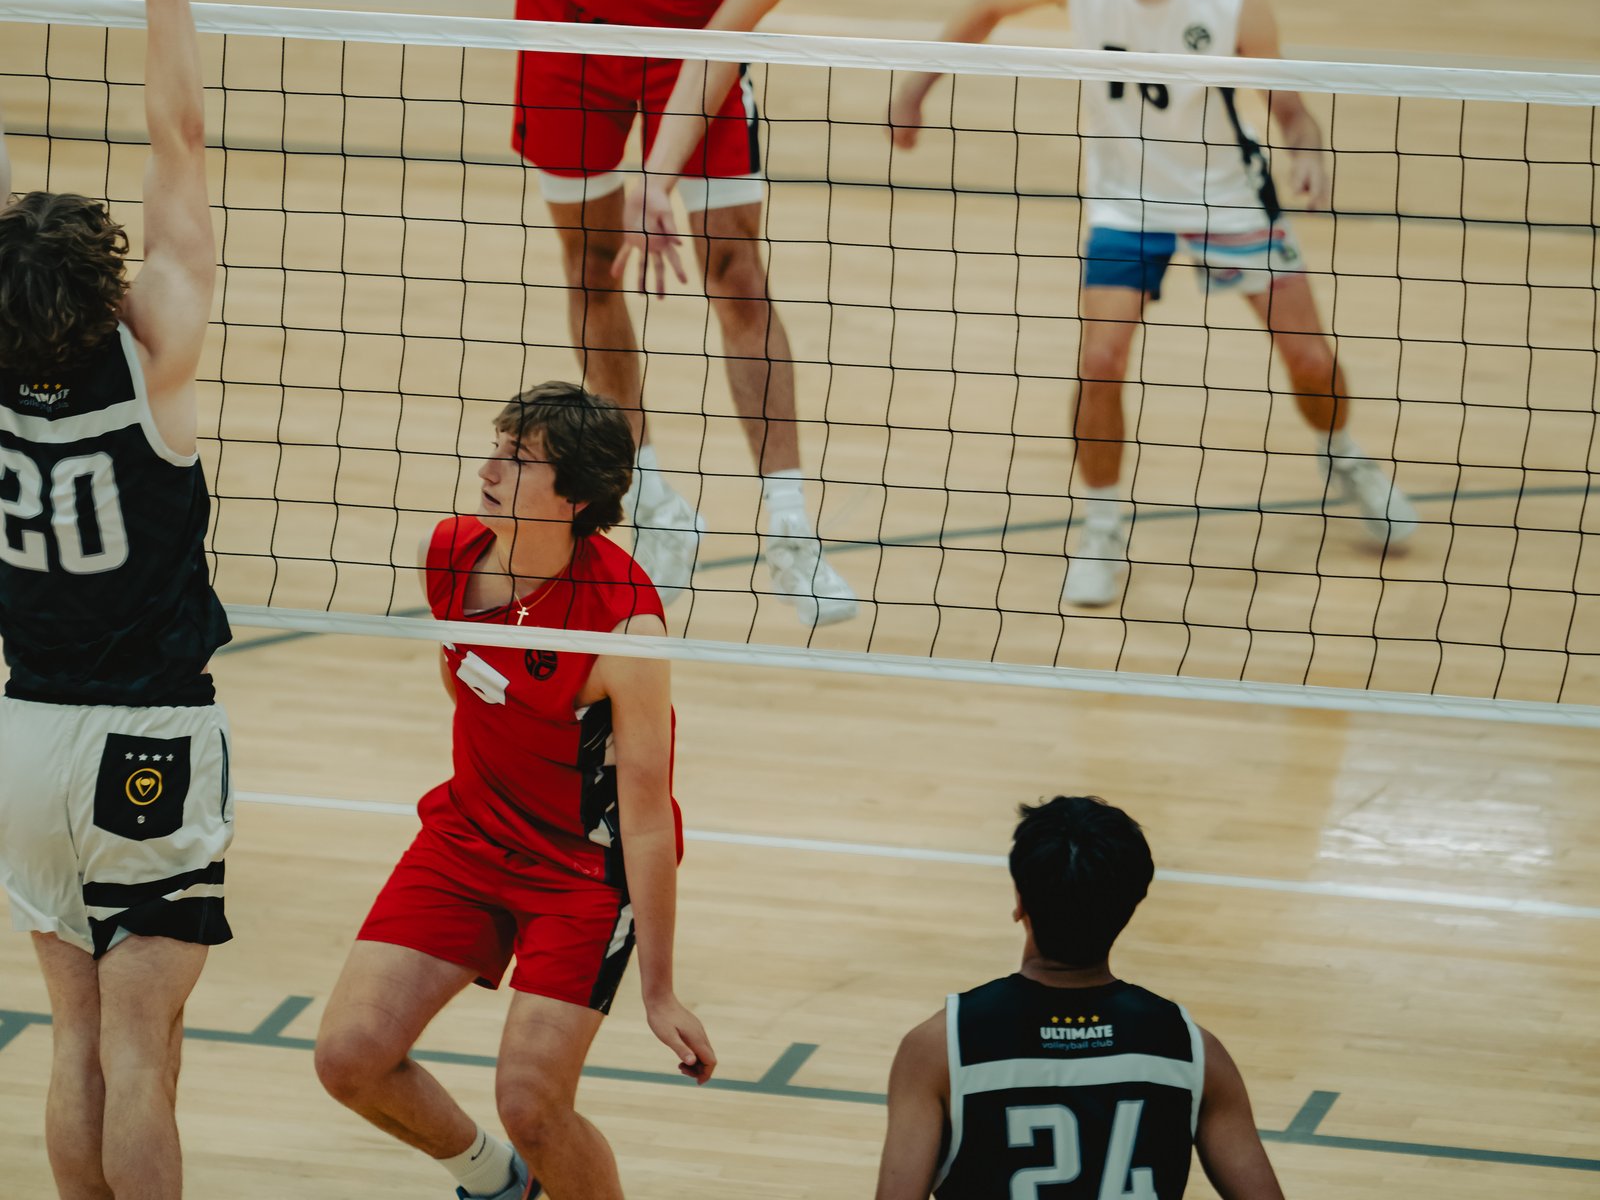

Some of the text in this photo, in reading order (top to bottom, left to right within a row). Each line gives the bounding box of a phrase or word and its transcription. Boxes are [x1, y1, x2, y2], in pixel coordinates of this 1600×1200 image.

[0, 445, 130, 575] 20
[1040, 1024, 1114, 1040] ULTIMATE
[1041, 1039, 1114, 1051] volleyball club
[1005, 1099, 1159, 1200] 24
